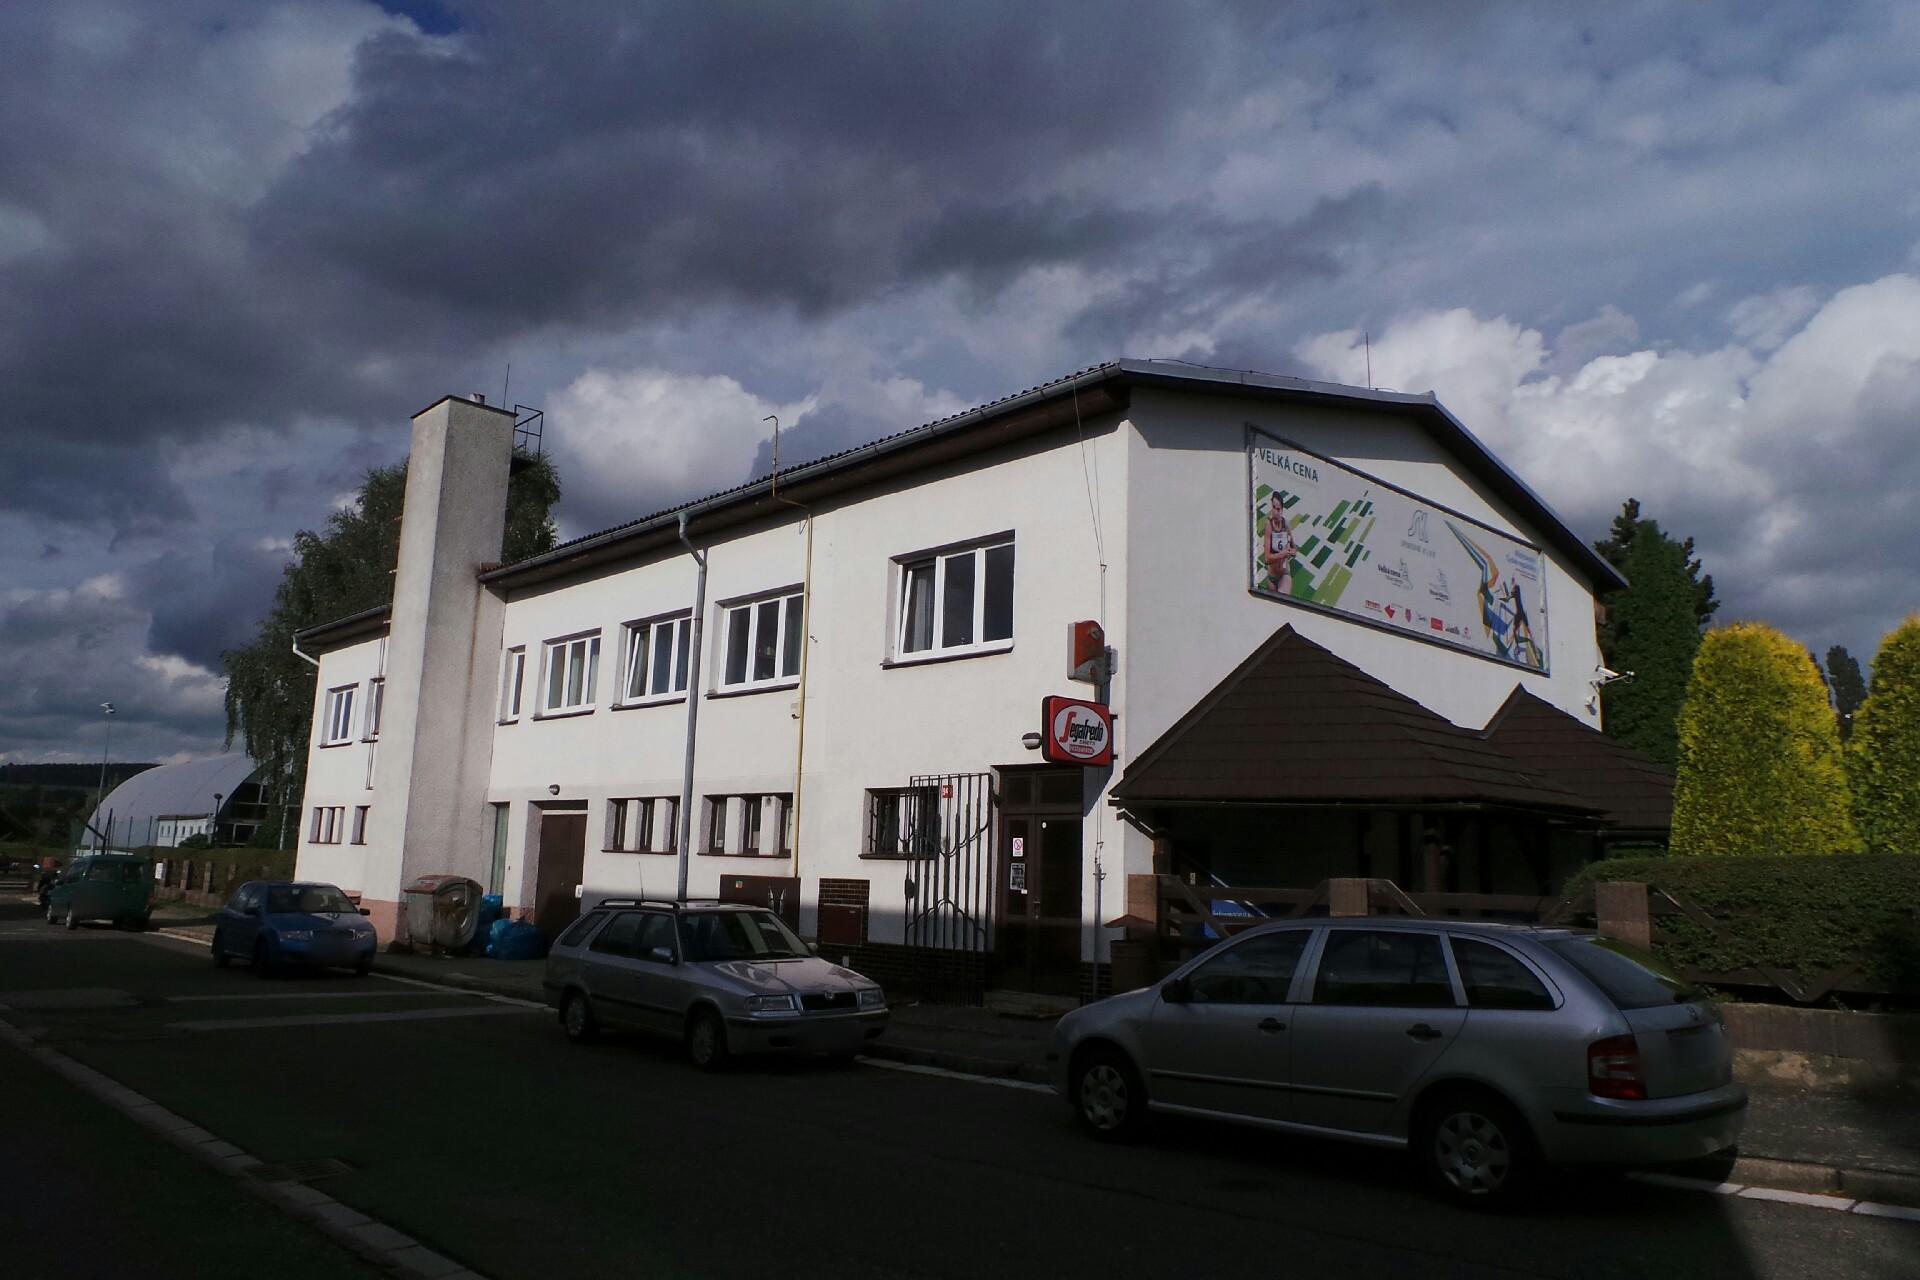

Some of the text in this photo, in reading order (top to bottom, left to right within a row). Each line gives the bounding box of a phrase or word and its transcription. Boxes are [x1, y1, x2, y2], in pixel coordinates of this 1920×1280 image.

[1259, 447, 1318, 482] VELKÁ CENA
[1277, 540, 1283, 551] 6
[1058, 711, 1103, 743] Segafredo
